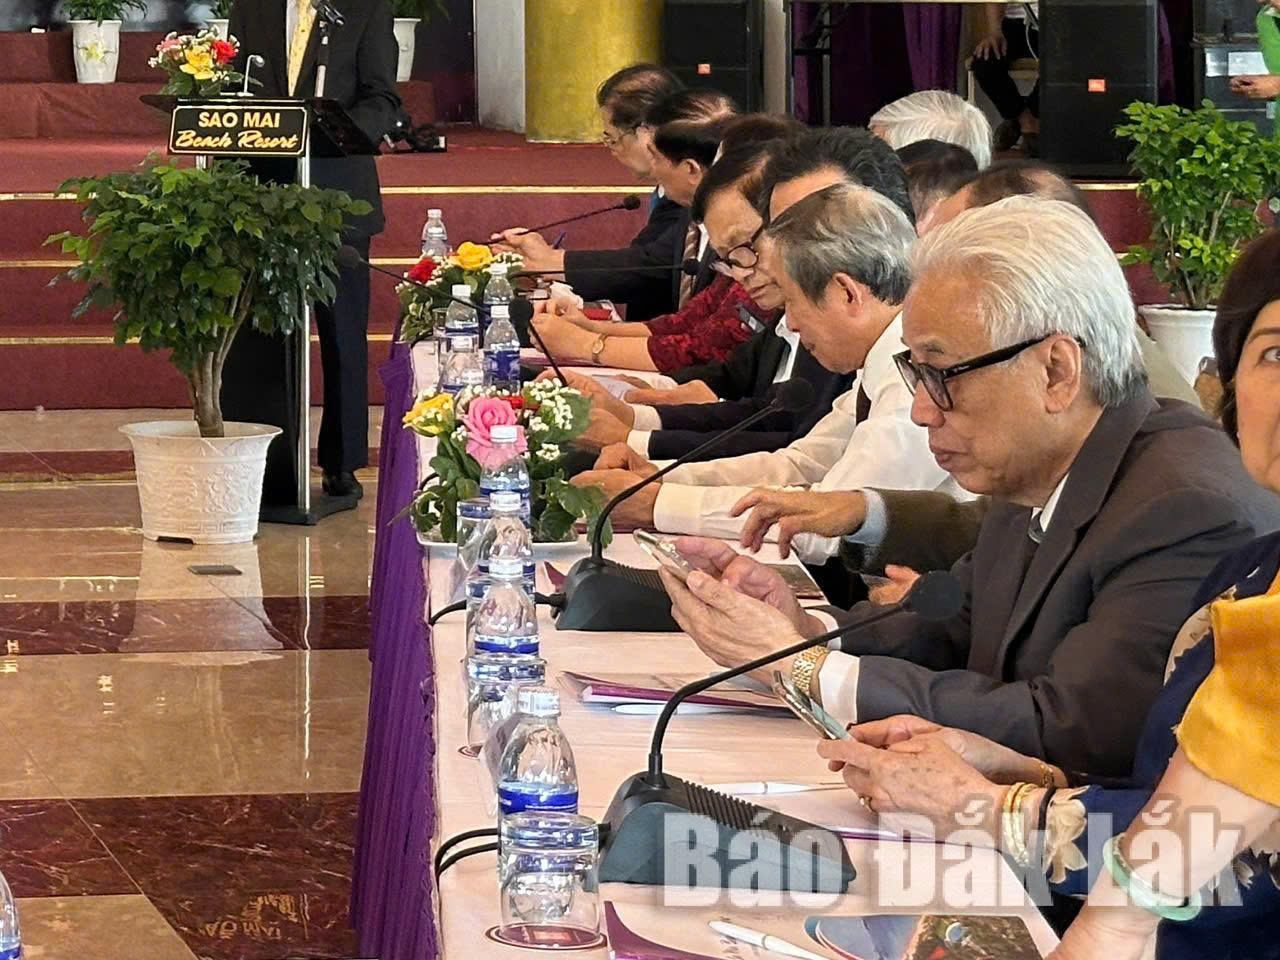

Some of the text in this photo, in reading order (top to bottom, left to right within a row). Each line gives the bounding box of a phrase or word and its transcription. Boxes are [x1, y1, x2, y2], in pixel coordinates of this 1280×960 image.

[198, 112, 280, 128] SAO MAI
[175, 129, 299, 149] Beach Resort
